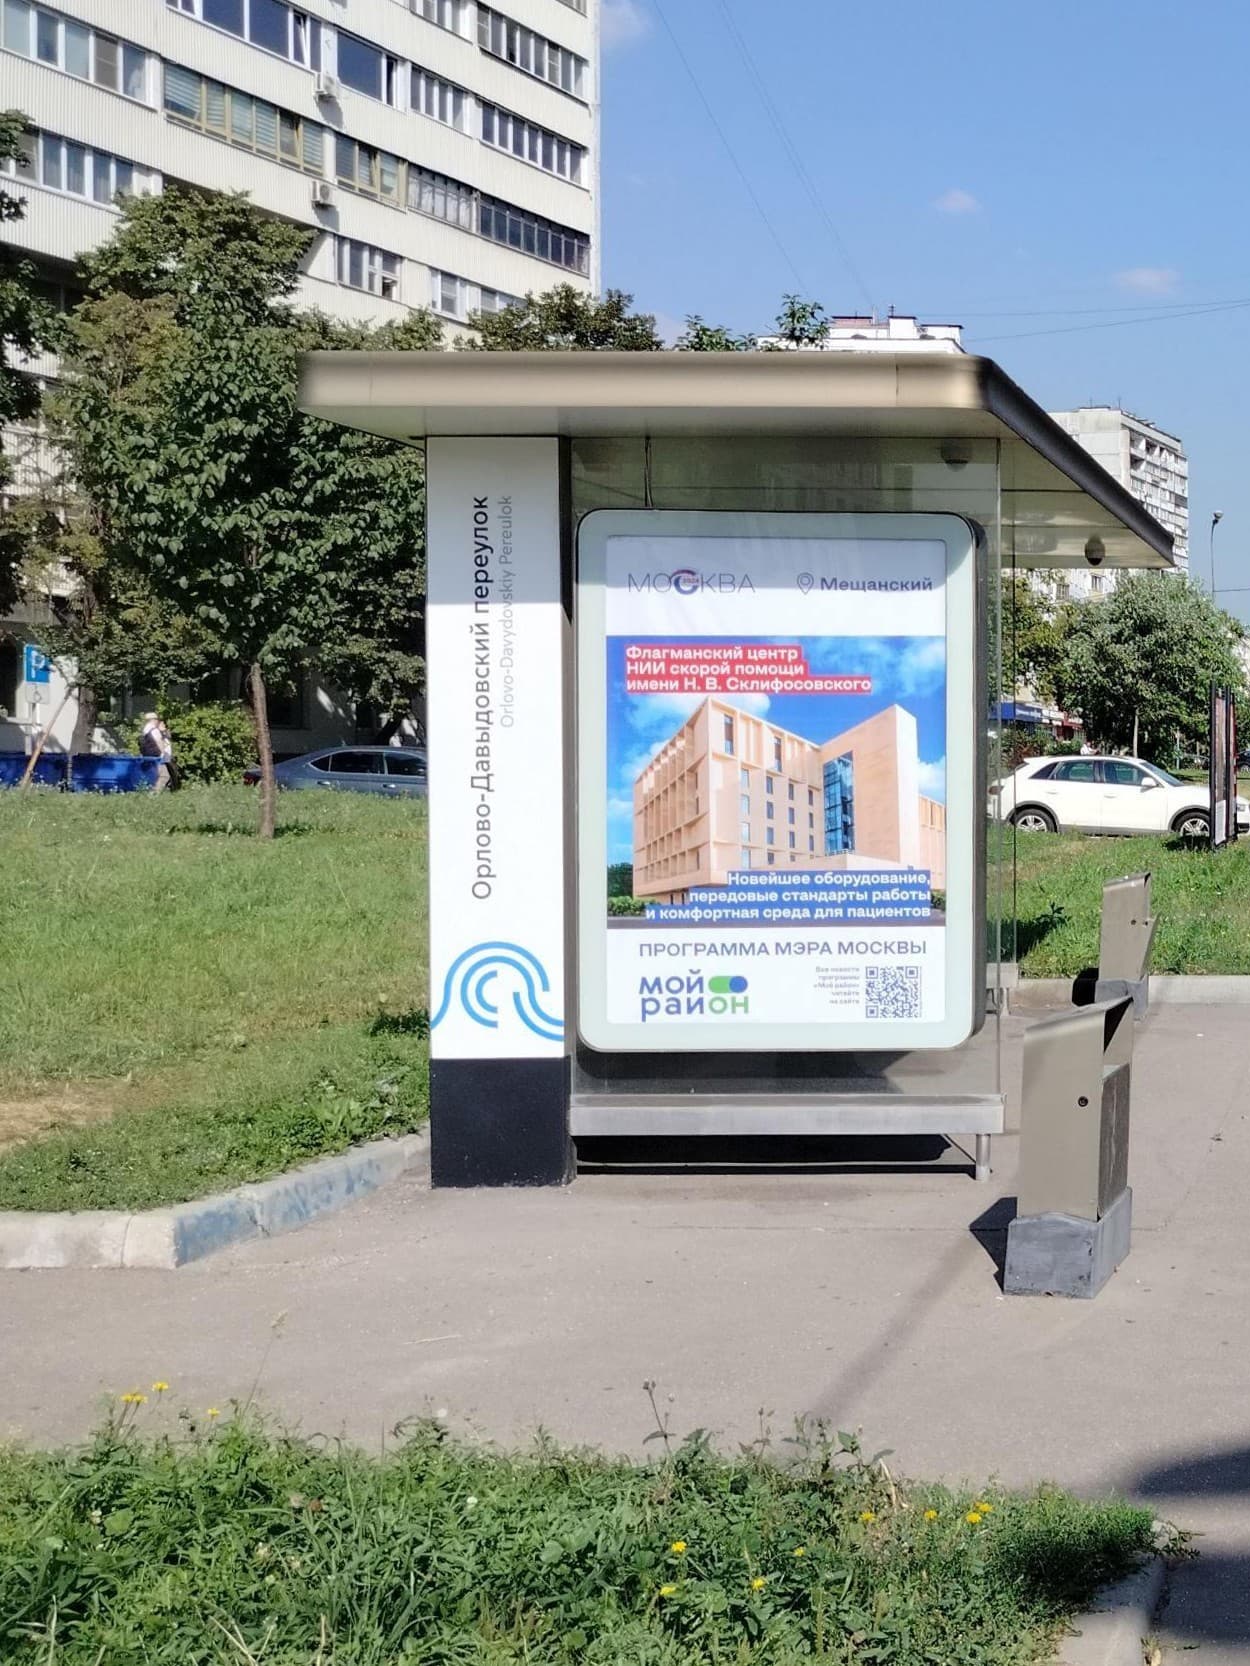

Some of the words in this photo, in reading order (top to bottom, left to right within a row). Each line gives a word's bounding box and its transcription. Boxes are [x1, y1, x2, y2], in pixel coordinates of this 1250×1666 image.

[499, 496, 513, 565] Pereulok
[472, 496, 496, 614] переулок
[627, 569, 756, 596] МОСКВА
[820, 577, 932, 593] Мещанский
[499, 569, 518, 728] Orlovo-Davydovskiy
[626, 646, 743, 660] Флагманский
[747, 649, 798, 664] центр
[627, 662, 666, 675] НИИ
[670, 661, 730, 679] скорой
[735, 664, 804, 677] помощи
[627, 679, 679, 690] имени
[684, 677, 701, 691] Н.
[706, 677, 722, 691] В.
[726, 677, 872, 693] Склифосовского
[470, 621, 496, 900] Орлово-Давыдовский
[728, 871, 810, 886] Новейшее
[814, 871, 931, 888] оборудование,
[690, 889, 778, 903] передовые
[782, 890, 867, 904] стандарты
[872, 889, 931, 902] работы
[646, 911, 655, 920] и
[660, 907, 759, 922] комфортная
[763, 908, 811, 921] среда
[814, 908, 843, 920] для
[847, 907, 931, 920] пациентов
[639, 942, 769, 957] ПРОГРАММА
[775, 941, 832, 956] МЭРА
[838, 940, 927, 955] МОСКВЫ
